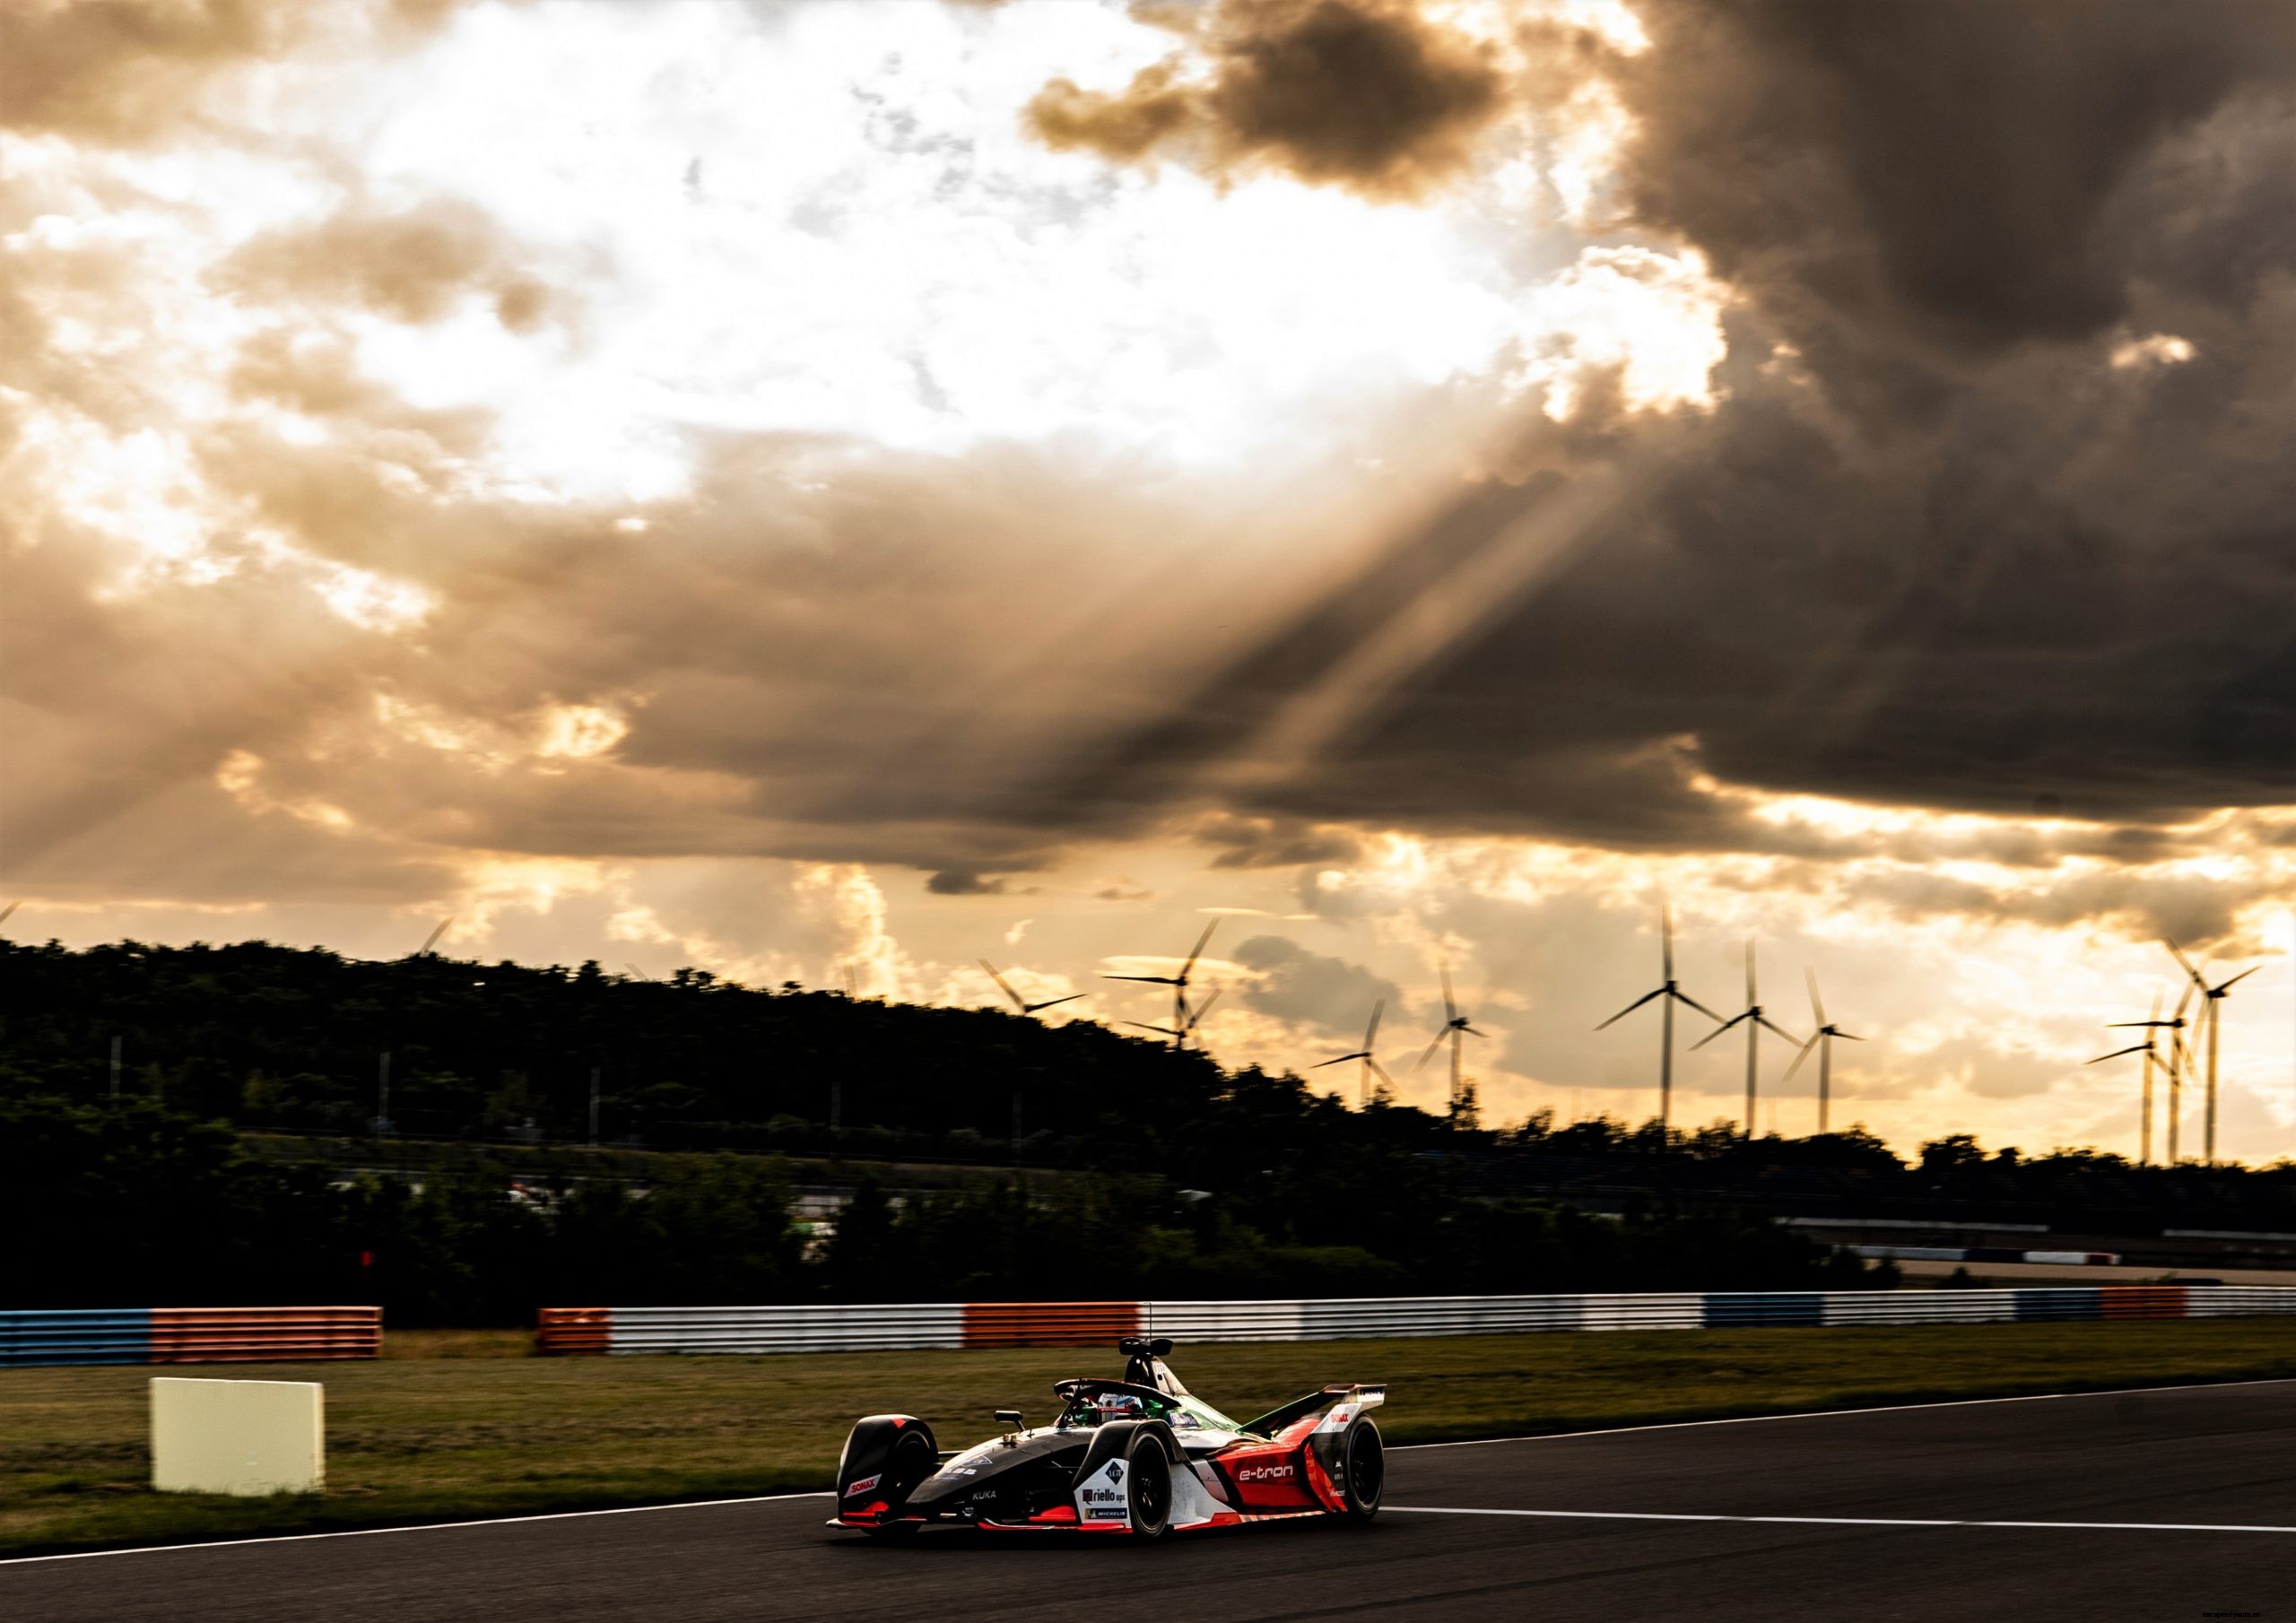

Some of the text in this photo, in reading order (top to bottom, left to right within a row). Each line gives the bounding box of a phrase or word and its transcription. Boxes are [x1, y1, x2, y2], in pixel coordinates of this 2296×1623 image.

[1239, 1465, 1293, 1481] e-tron
[851, 1479, 874, 1492] SONAX
[972, 1490, 996, 1500] KUKA
[1093, 1488, 1125, 1504] riello ups
